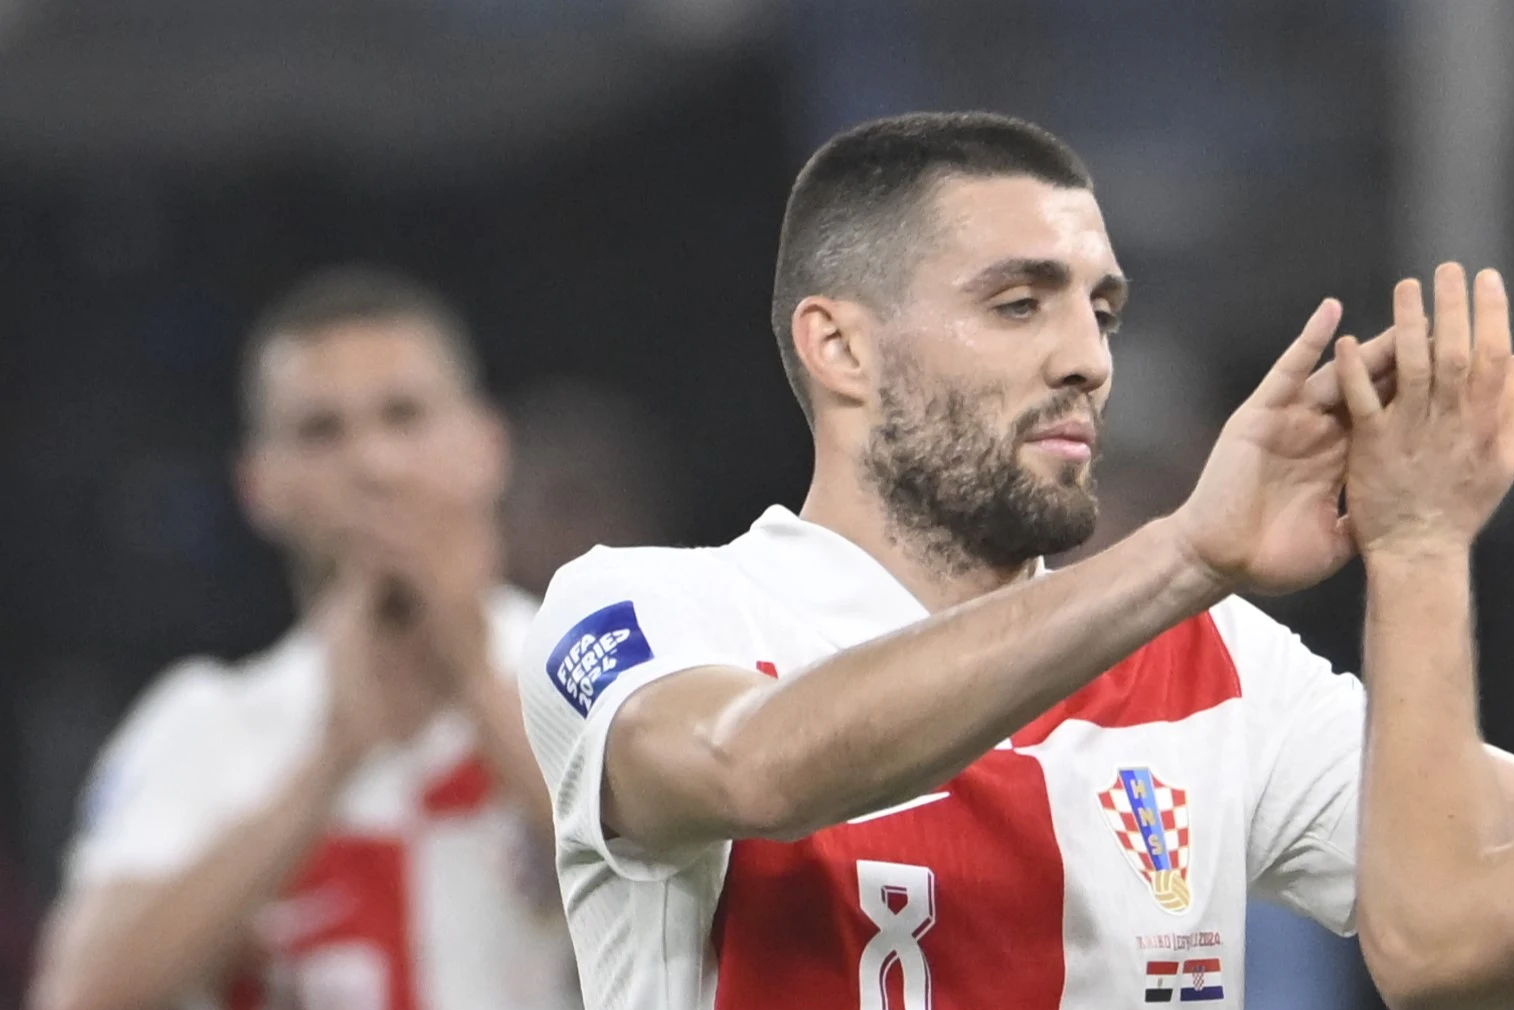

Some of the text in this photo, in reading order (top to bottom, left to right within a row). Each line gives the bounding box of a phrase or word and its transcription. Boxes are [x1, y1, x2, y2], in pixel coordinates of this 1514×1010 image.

[557, 633, 596, 686] FIFA
[566, 627, 631, 699] SERIES
[1130, 779, 1164, 856] HNS
